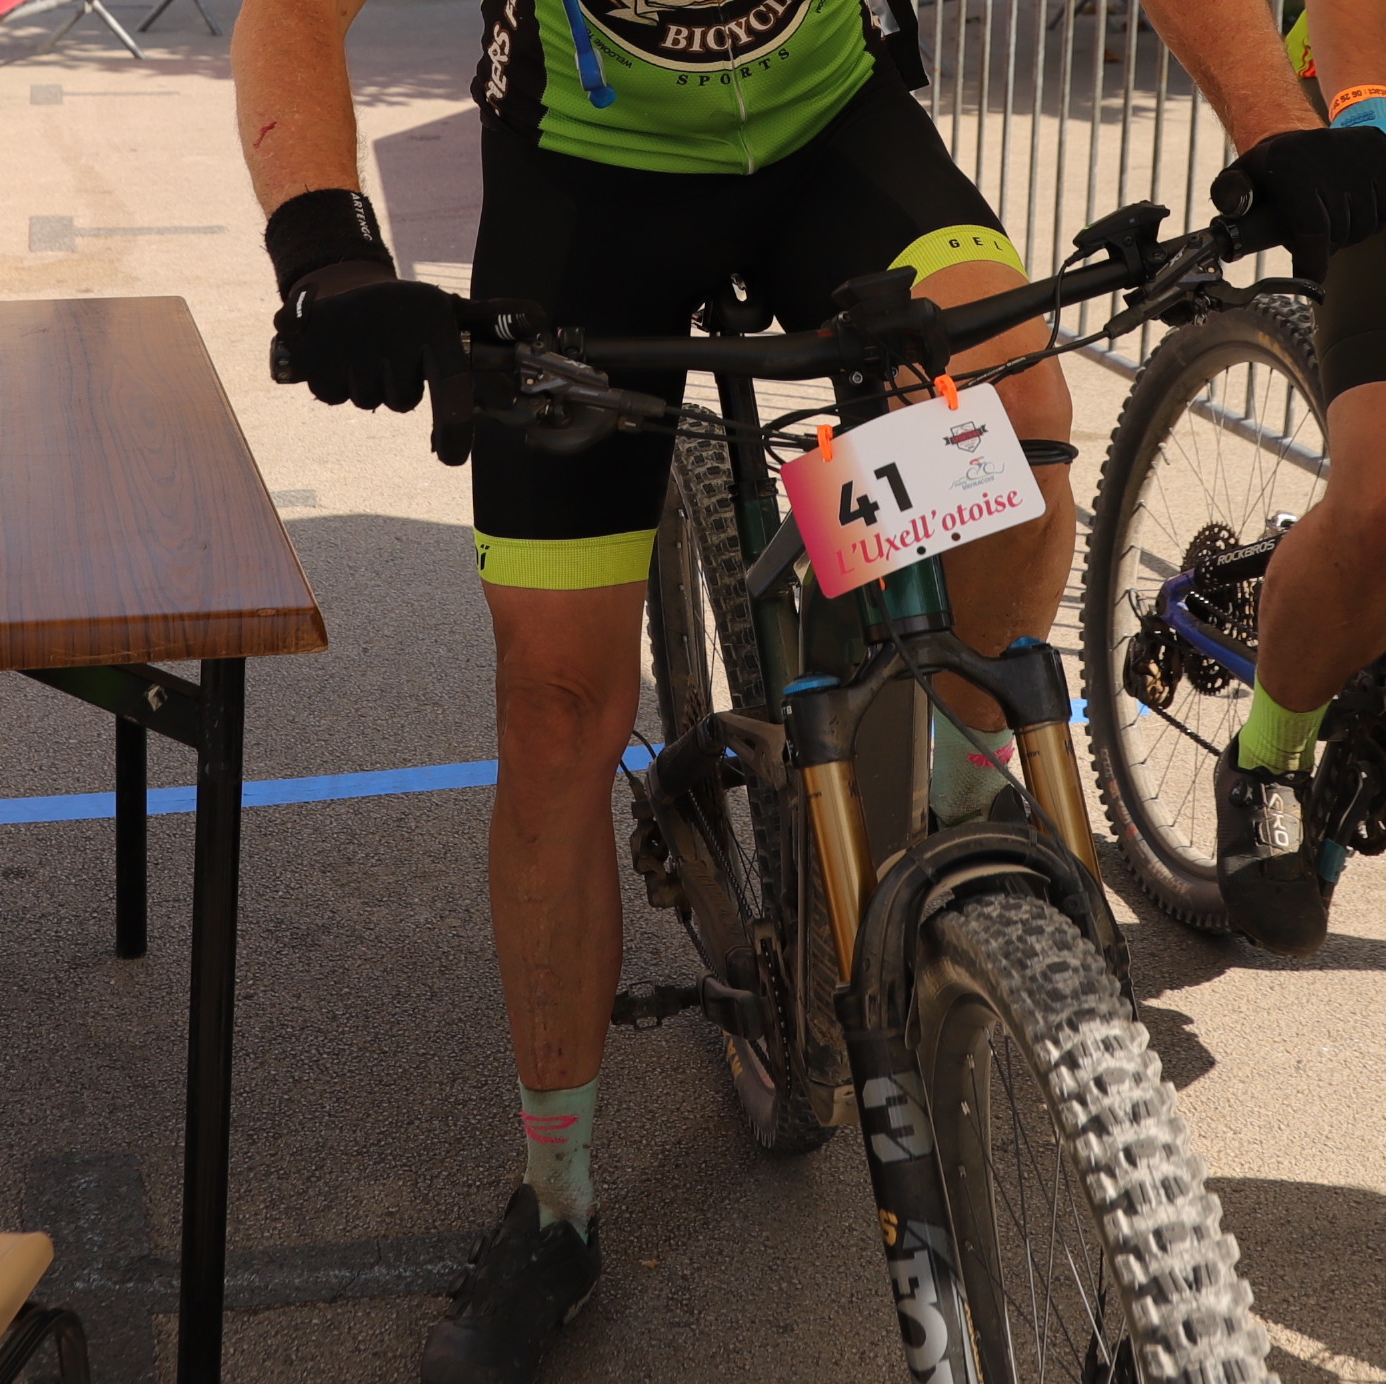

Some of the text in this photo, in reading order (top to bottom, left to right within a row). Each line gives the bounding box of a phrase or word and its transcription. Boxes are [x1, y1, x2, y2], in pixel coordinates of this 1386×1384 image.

[592, 37, 633, 70] WELCOME
[675, 47, 791, 87] SPORTS
[838, 462, 914, 528] 41
[835, 489, 1024, 577] L'Uxell'otoise
[1216, 538, 1276, 566] ROCKBROS
